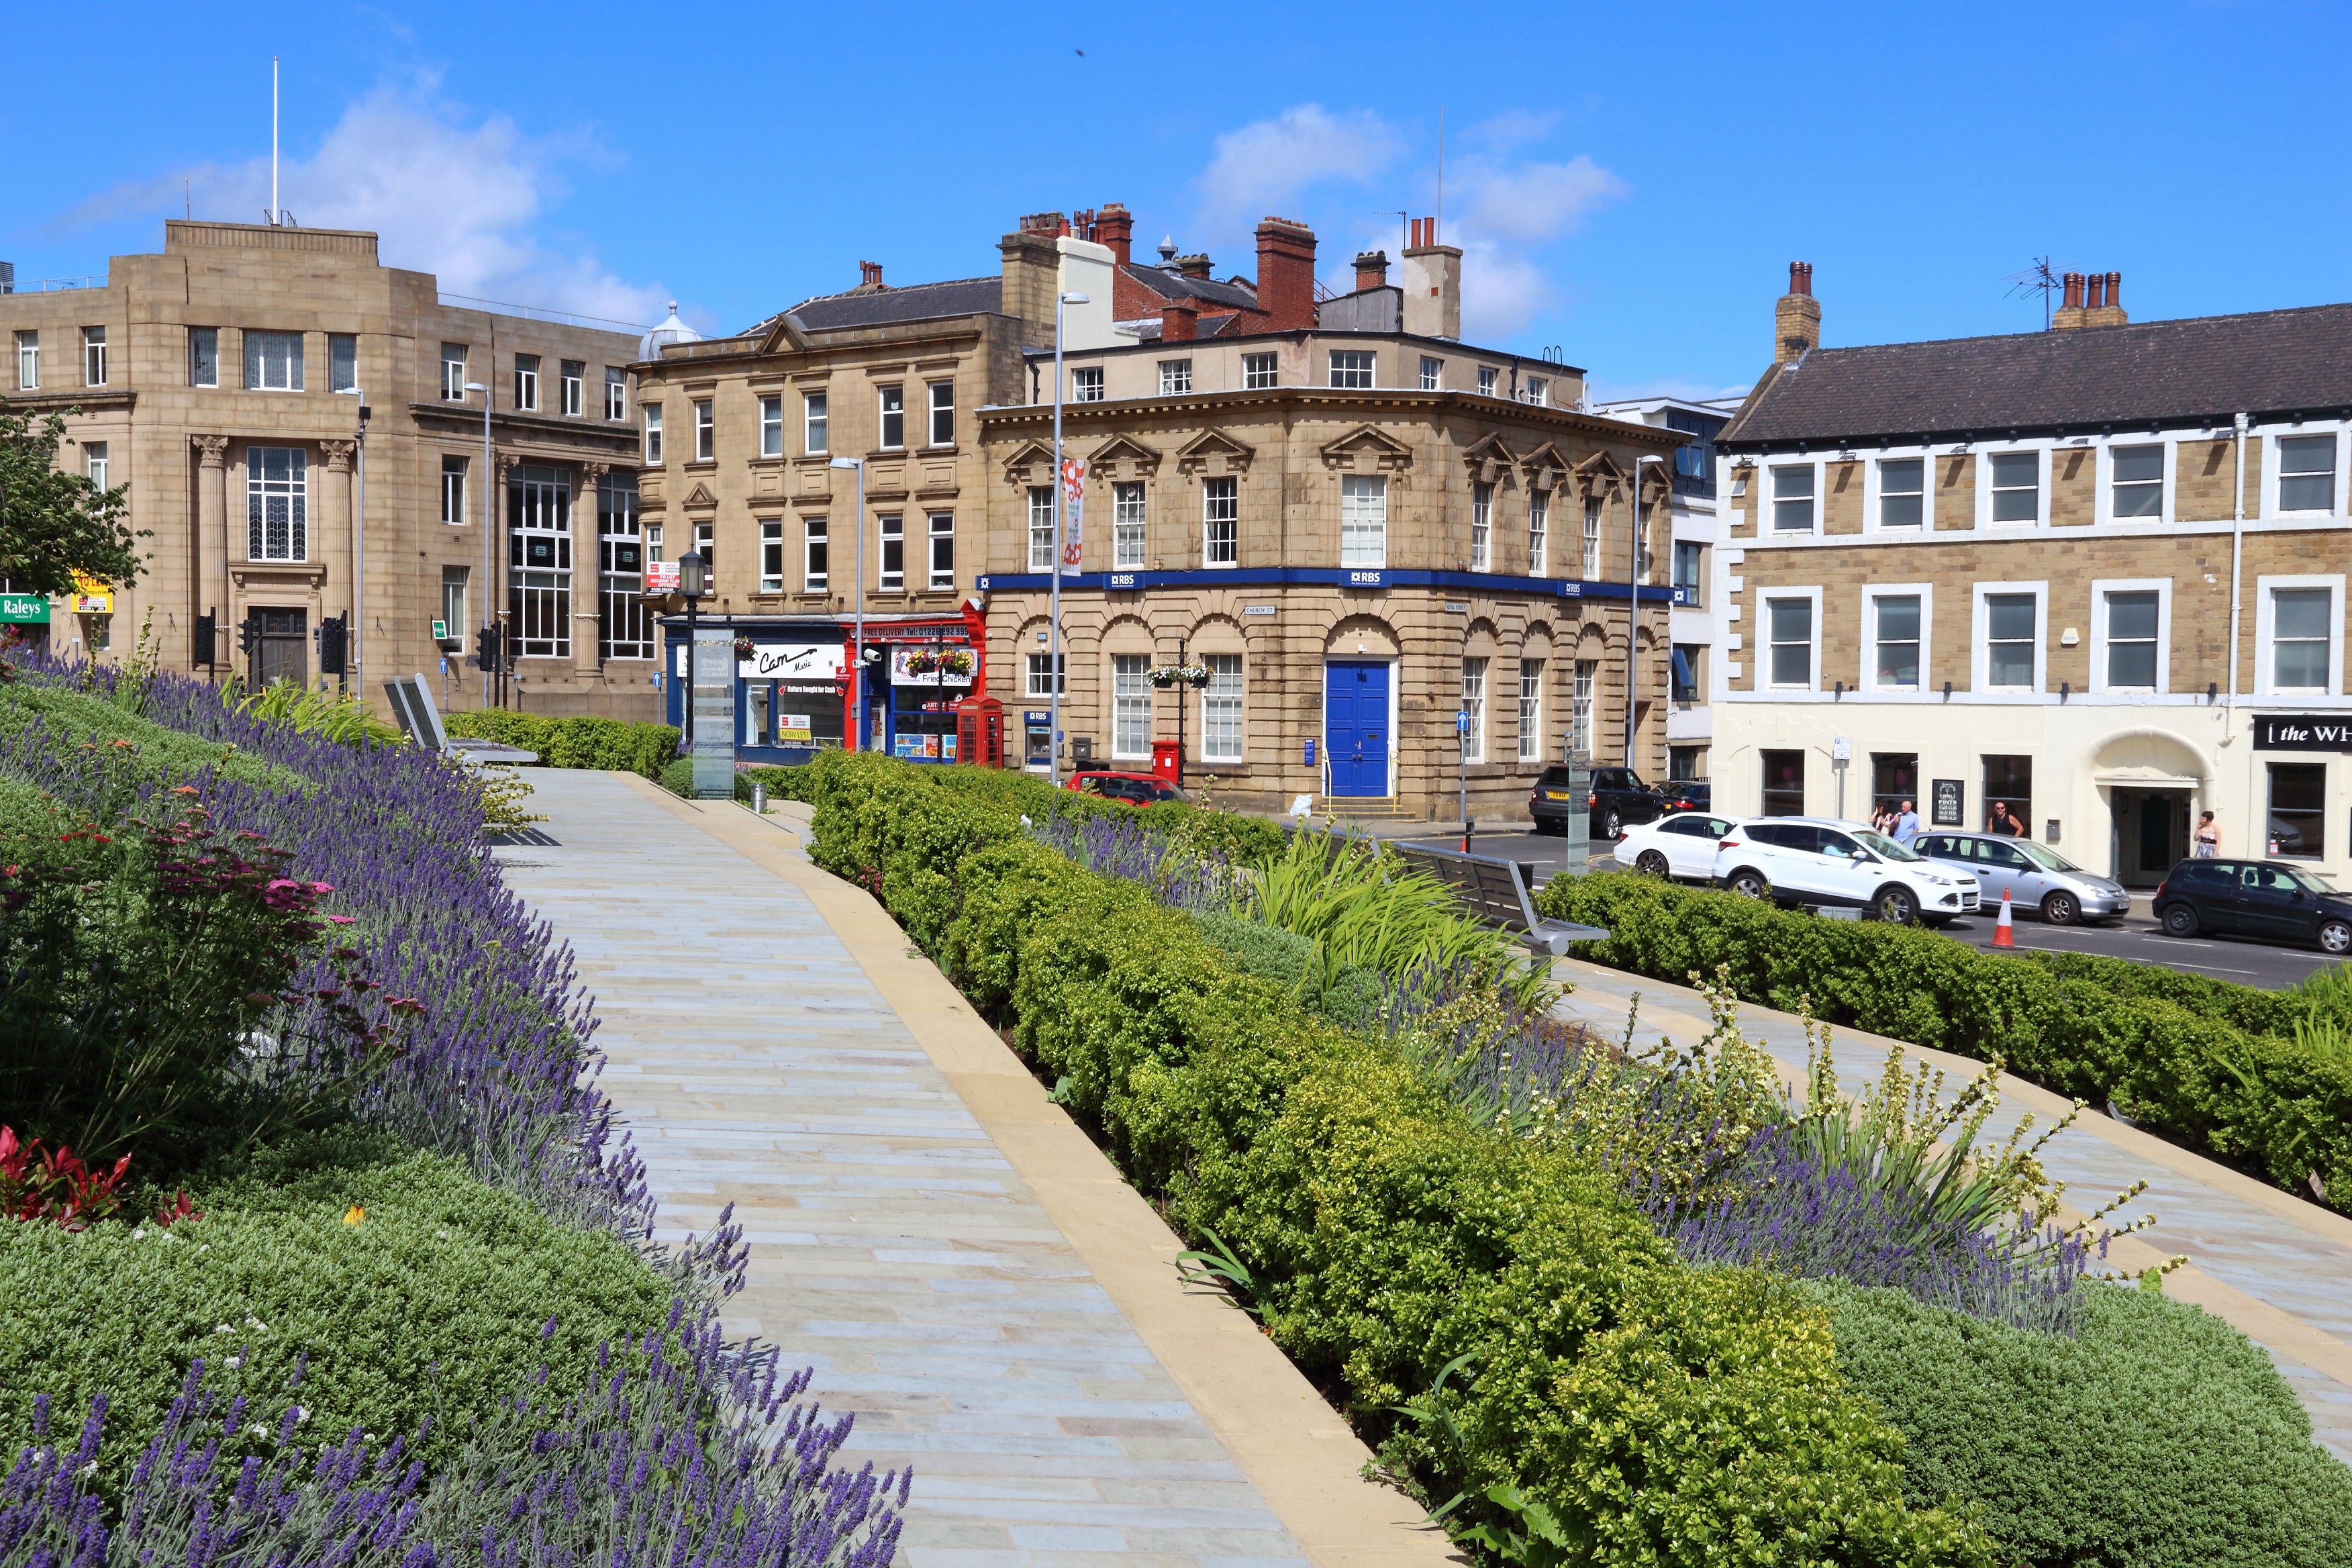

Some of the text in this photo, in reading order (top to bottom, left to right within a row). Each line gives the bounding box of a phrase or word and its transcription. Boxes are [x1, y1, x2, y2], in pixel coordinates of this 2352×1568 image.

[79, 577, 89, 587] TO
[1119, 575, 1134, 584] RBS
[1361, 572, 1380, 583] RBS
[1571, 583, 1580, 593] RBS
[4, 599, 40, 618] Raleys
[864, 626, 969, 636] FREE DELIVERY Tel: 01226 292 999
[760, 652, 792, 674] Cam
[793, 660, 812, 673] Music
[941, 675, 971, 683] Chicken
[787, 685, 803, 693] Guitars
[803, 685, 818, 694] Bought
[825, 685, 836, 693] Cash
[2280, 725, 2308, 741] the
[2313, 726, 2352, 742] WH
